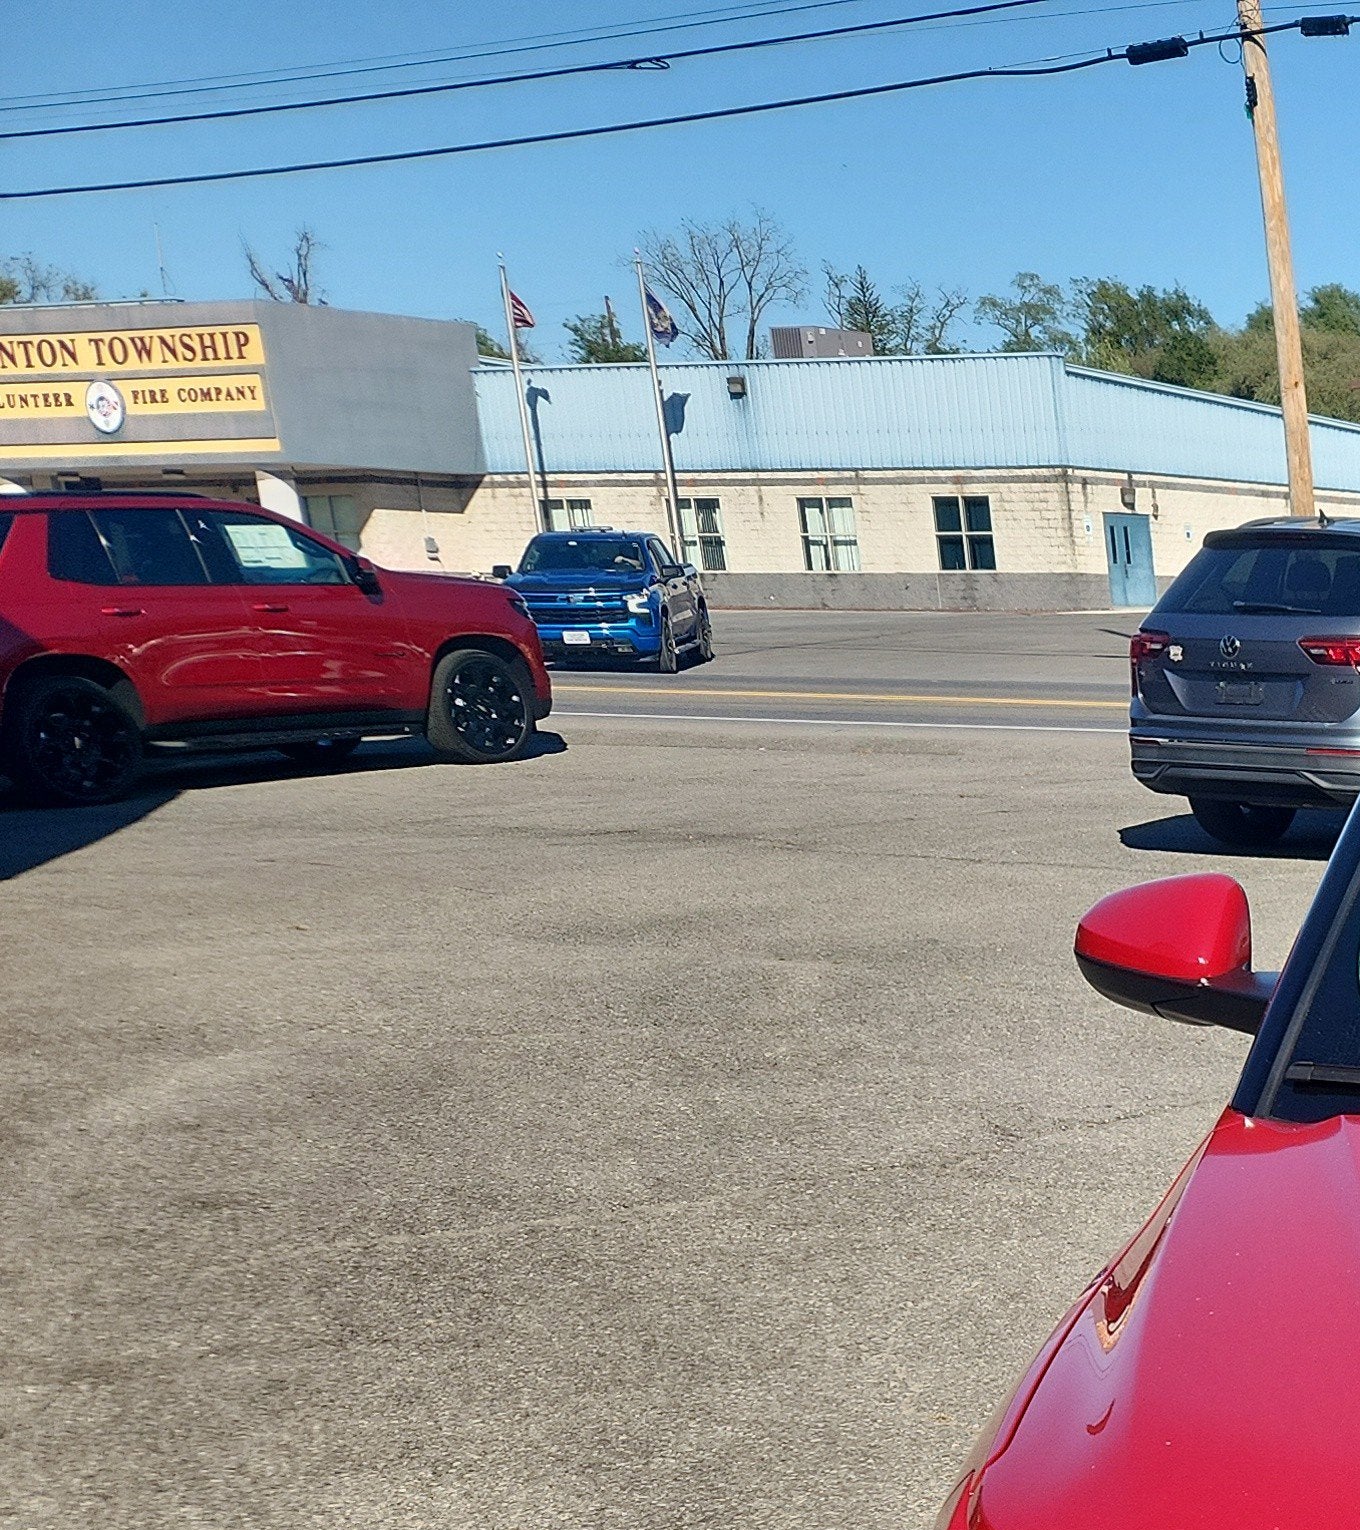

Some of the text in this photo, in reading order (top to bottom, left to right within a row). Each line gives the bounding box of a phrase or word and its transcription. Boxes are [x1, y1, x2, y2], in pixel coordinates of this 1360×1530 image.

[88, 330, 251, 367] TOWNSHIP
[131, 387, 170, 405] FIRE
[177, 385, 259, 403] COMPANY
